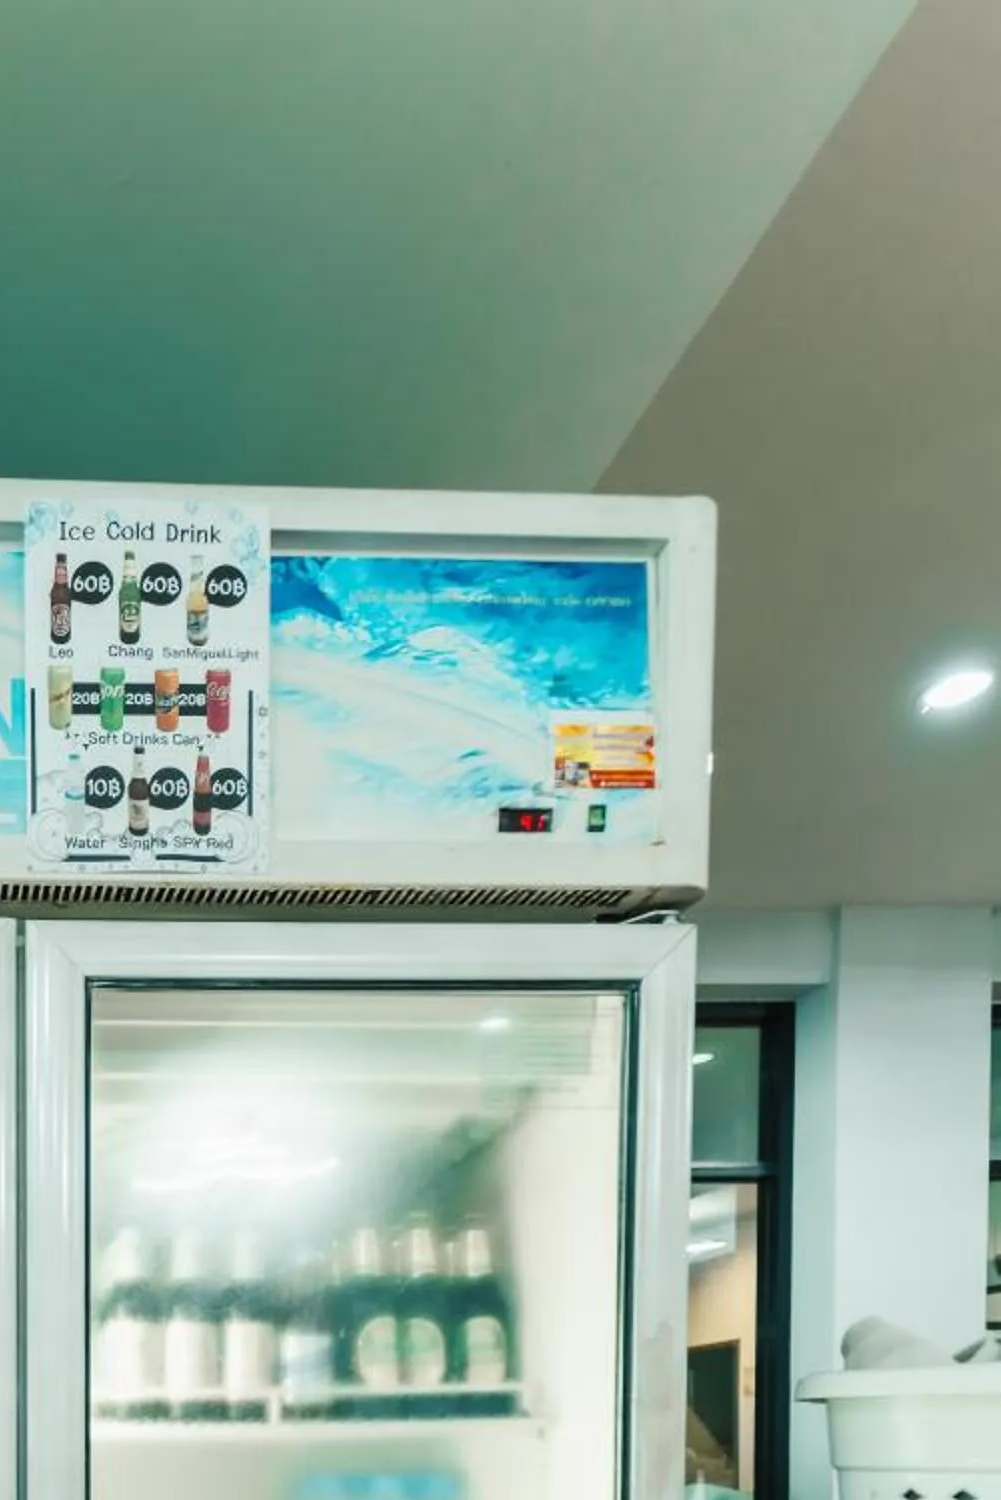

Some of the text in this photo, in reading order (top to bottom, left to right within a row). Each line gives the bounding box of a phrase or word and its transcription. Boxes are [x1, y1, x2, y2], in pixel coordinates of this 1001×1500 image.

[59, 521, 221, 543] Ice Cold Drink
[49, 647, 74, 660] Leo
[108, 645, 153, 661] Chang
[88, 732, 200, 746] Soft Drinks Can
[65, 836, 106, 850] Water
